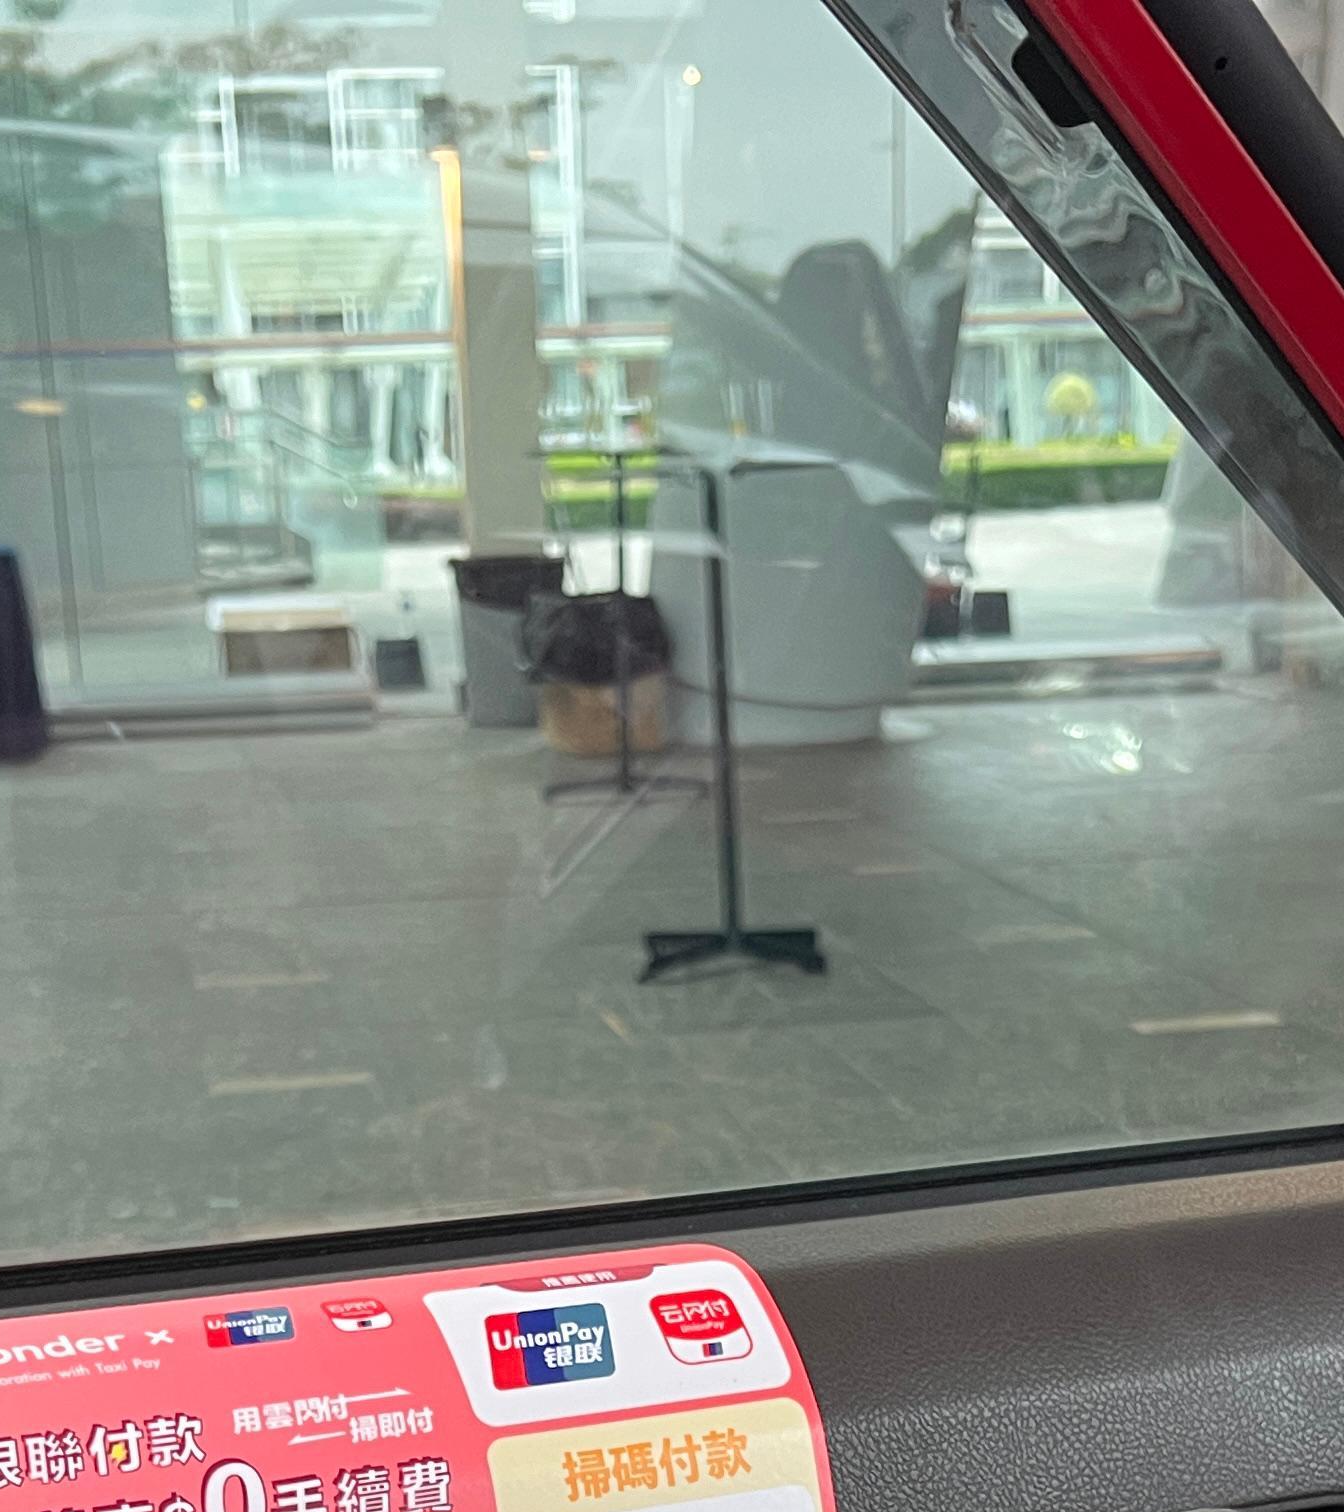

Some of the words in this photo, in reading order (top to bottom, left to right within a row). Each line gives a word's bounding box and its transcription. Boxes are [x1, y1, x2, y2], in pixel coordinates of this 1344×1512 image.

[207, 1314, 288, 1331] UnionPay
[490, 1322, 605, 1352] UnionPay
[58, 1366, 90, 1379] with
[95, 1361, 127, 1374] Taxi
[132, 1357, 161, 1371] Pay
[543, 1343, 604, 1369] 银联
[561, 1427, 752, 1502] 掃碼付款
